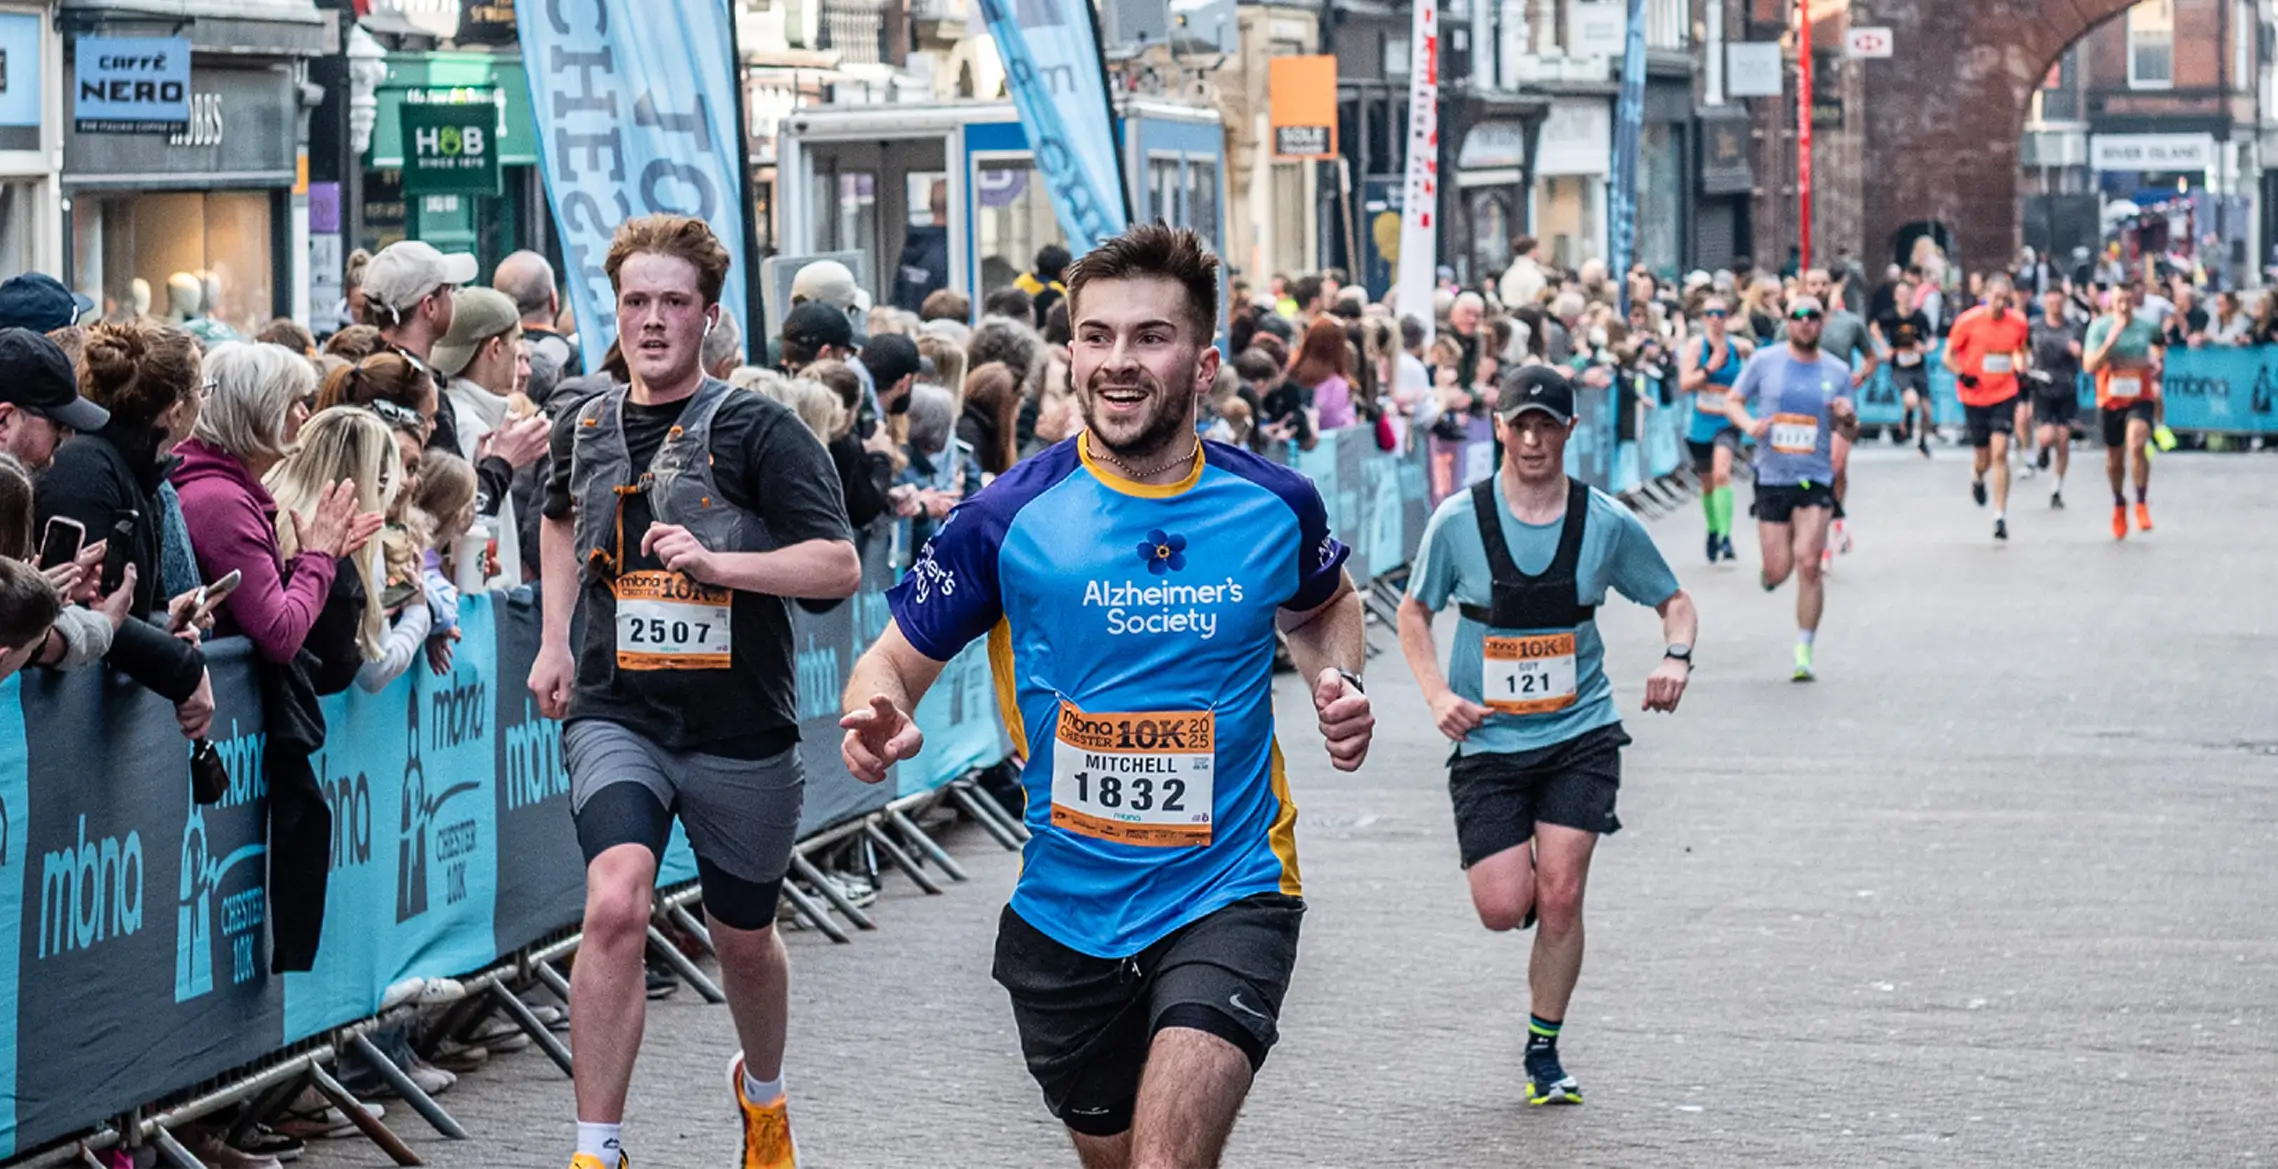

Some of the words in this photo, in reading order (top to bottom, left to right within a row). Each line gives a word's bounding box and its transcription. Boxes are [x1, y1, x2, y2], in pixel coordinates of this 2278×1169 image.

[81, 78, 183, 104] NERO
[621, 575, 660, 587] mbna
[1083, 577, 1243, 607] Alzheimer's
[630, 618, 711, 643] 2507
[1107, 607, 1217, 640] Society
[1519, 639, 1559, 657] 10K
[1518, 662, 1539, 671] GUY
[1506, 673, 1549, 693] 121
[433, 671, 485, 750] mbna
[1063, 710, 1113, 735] mbna
[1060, 725, 1112, 747] CHESTER
[1116, 719, 1187, 749] 10K
[1189, 718, 1209, 733] 20
[1189, 733, 1209, 748] 25
[1086, 754, 1177, 773] MITCHELL
[1074, 772, 1186, 811] 1832
[321, 753, 371, 873] bna
[38, 813, 143, 960] mbna
